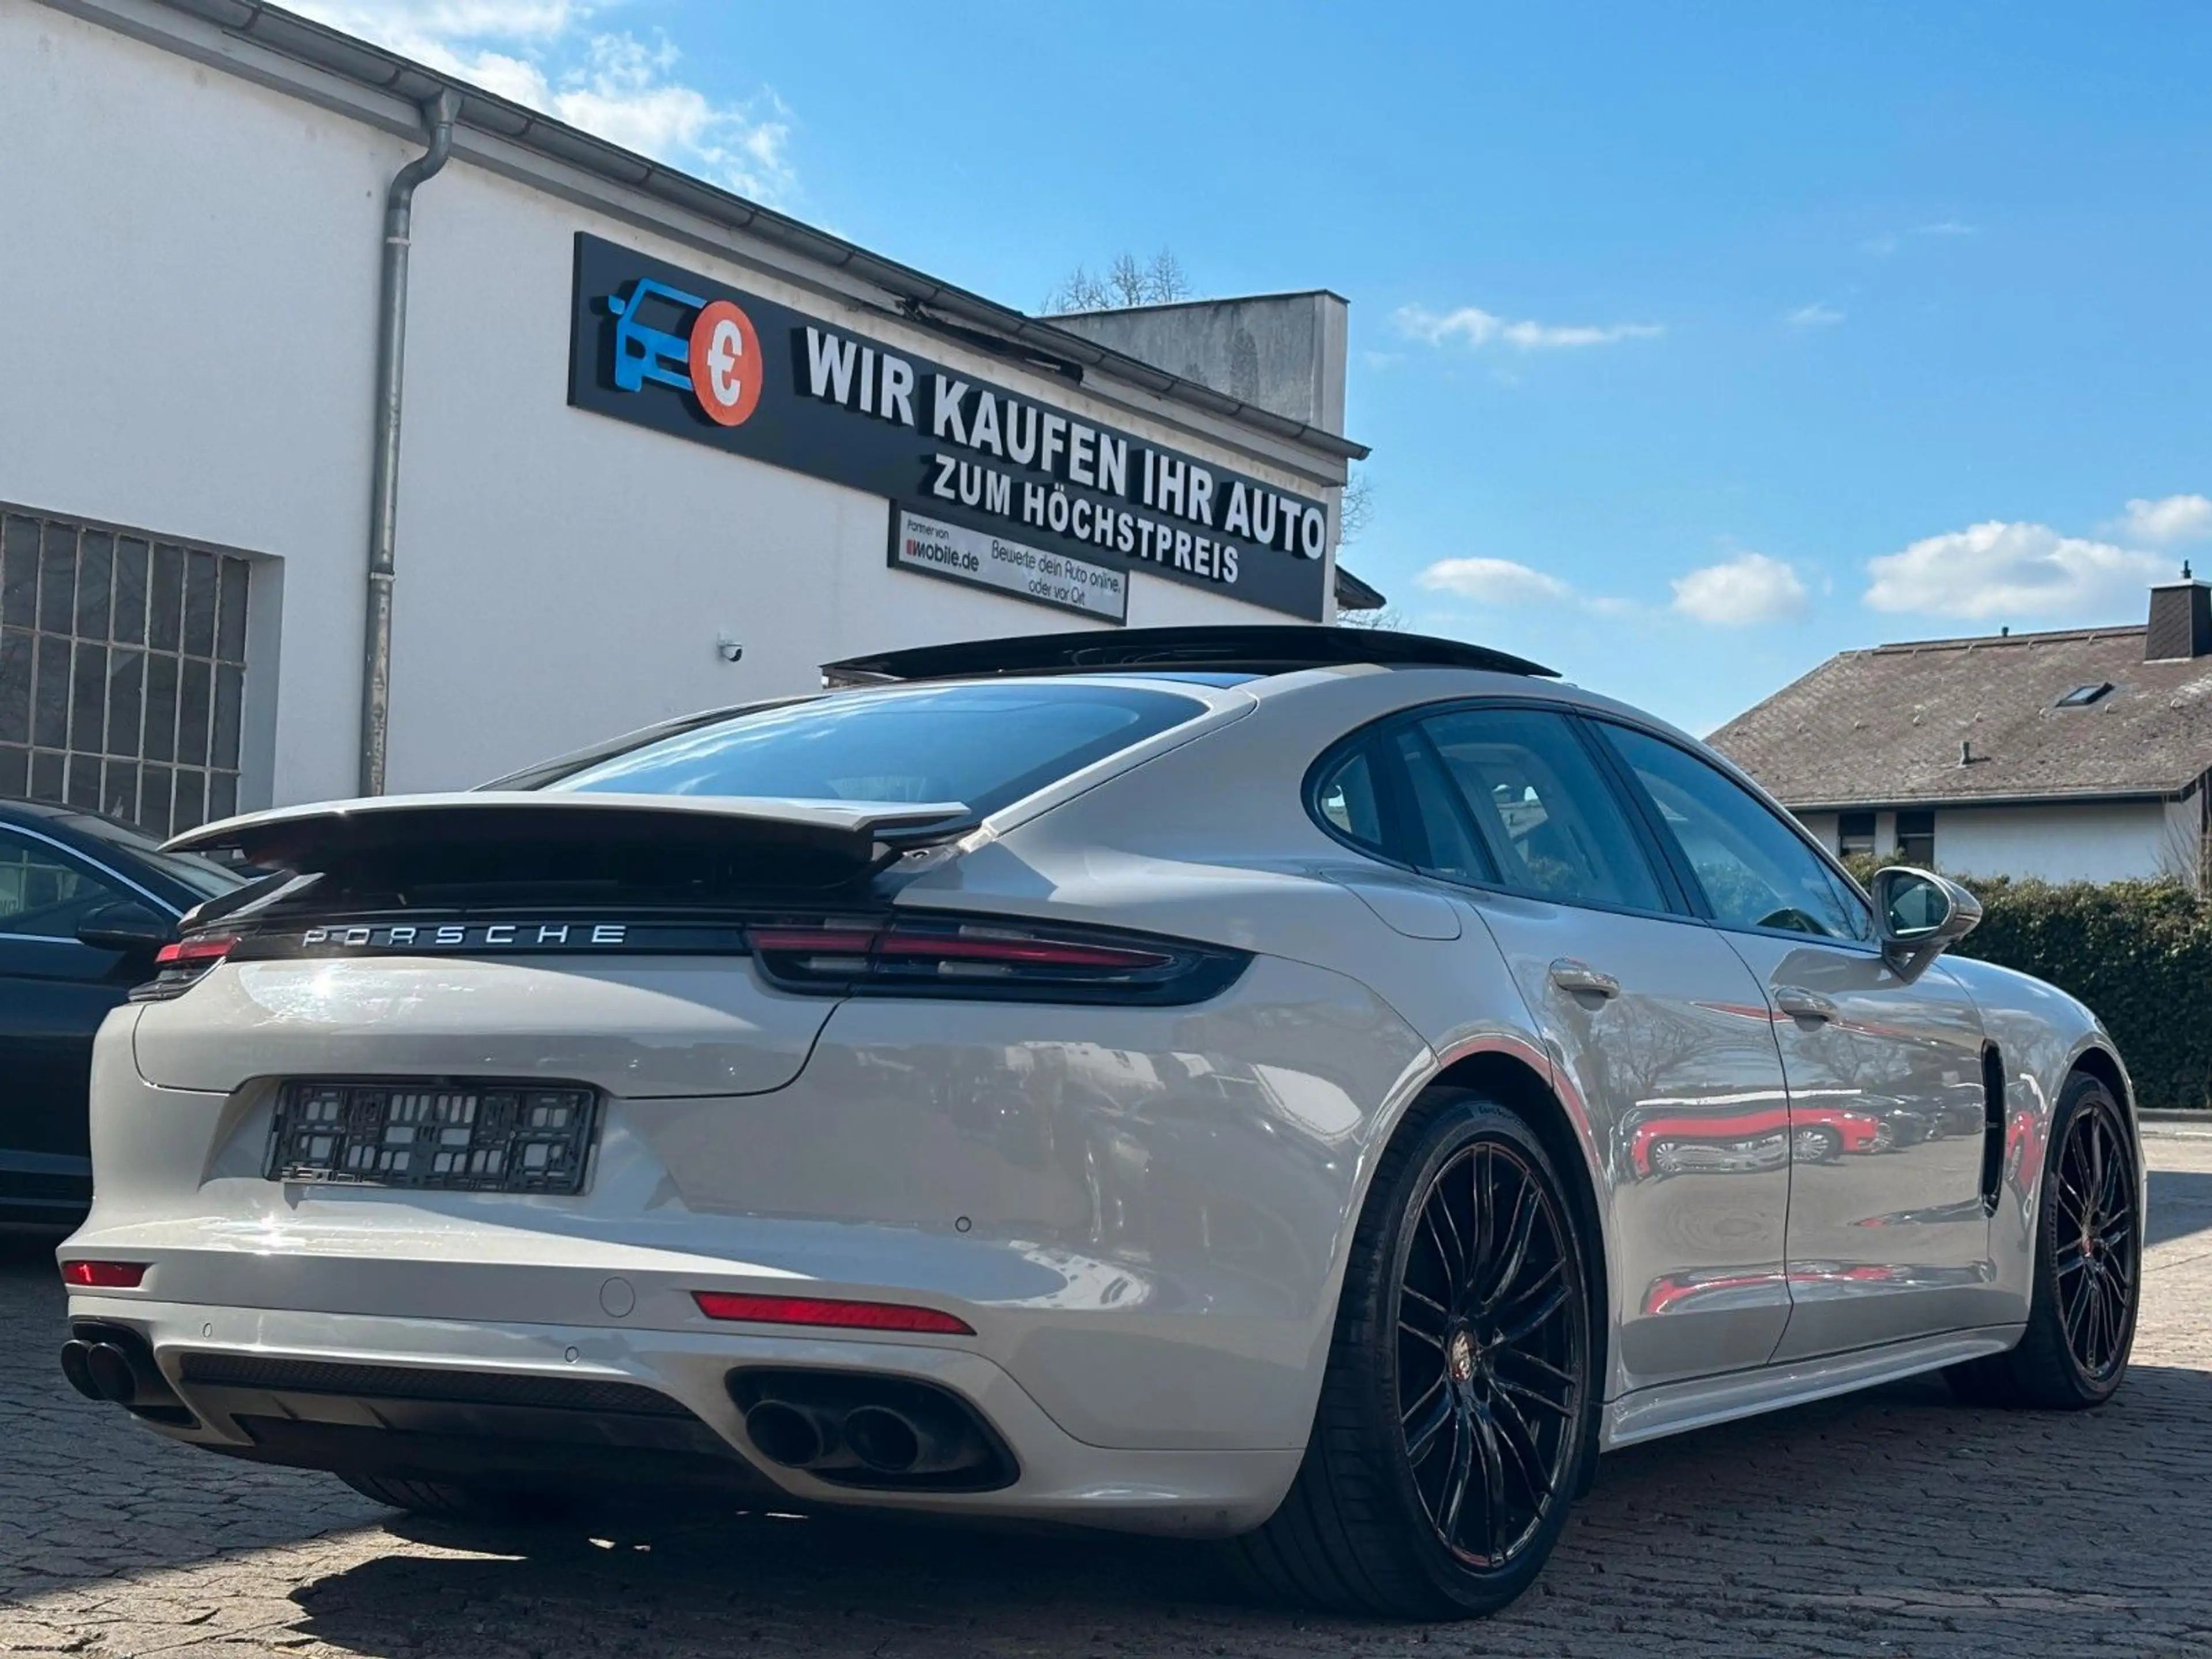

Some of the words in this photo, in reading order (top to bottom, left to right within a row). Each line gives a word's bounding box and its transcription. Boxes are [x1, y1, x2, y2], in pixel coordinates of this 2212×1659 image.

[806, 325, 914, 427] WIR
[933, 374, 1127, 497] KAUFEN
[1143, 449, 1213, 525] IHR
[1225, 481, 1325, 560] AUTO
[933, 453, 1010, 516] ZUM
[1023, 482, 1239, 584] HÖCHSTPREIS
[991, 540, 1035, 569] Bewerte
[1038, 554, 1062, 577] dein
[1065, 560, 1088, 584] Auto
[1028, 578, 1051, 597] oder
[1055, 585, 1070, 600] vor
[1071, 586, 1085, 605] Ort
[303, 925, 626, 948] PORSCHE
